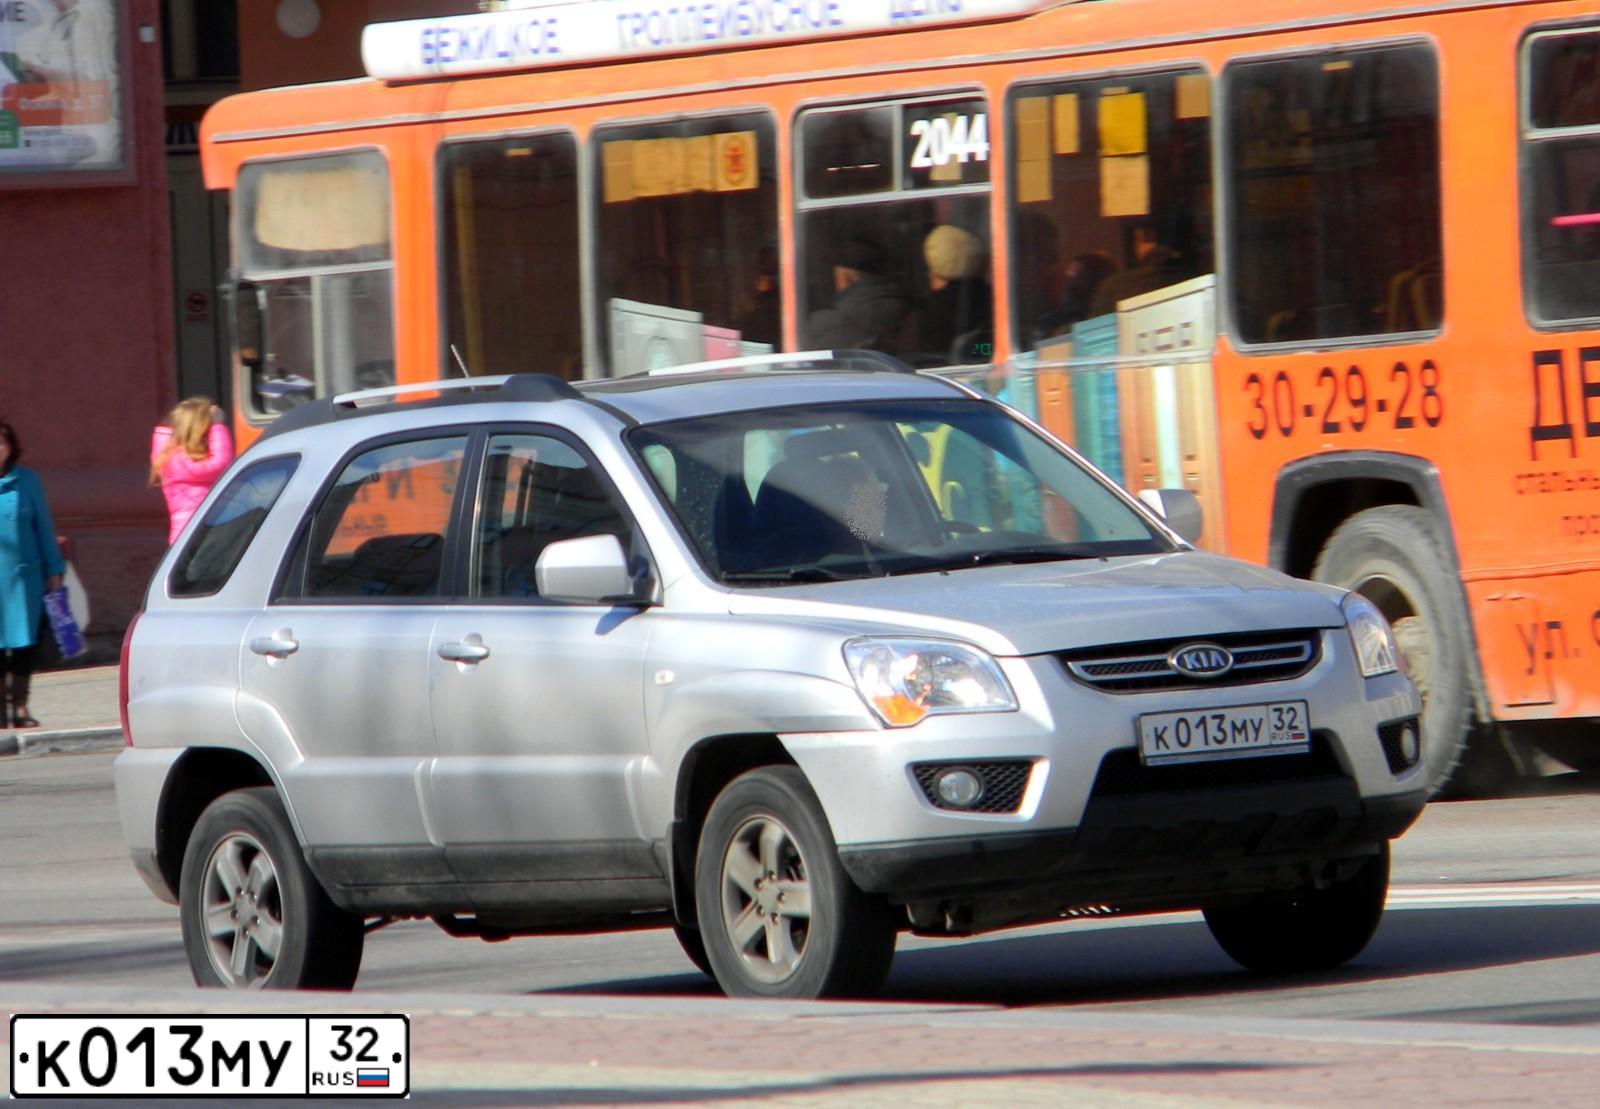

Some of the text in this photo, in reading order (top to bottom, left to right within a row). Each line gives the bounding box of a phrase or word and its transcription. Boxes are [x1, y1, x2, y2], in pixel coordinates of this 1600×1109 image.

[909, 113, 990, 168] 2044
[1244, 360, 1443, 440] 30-29-28
[1183, 650, 1226, 670] KIA
[1272, 706, 1299, 732] 32
